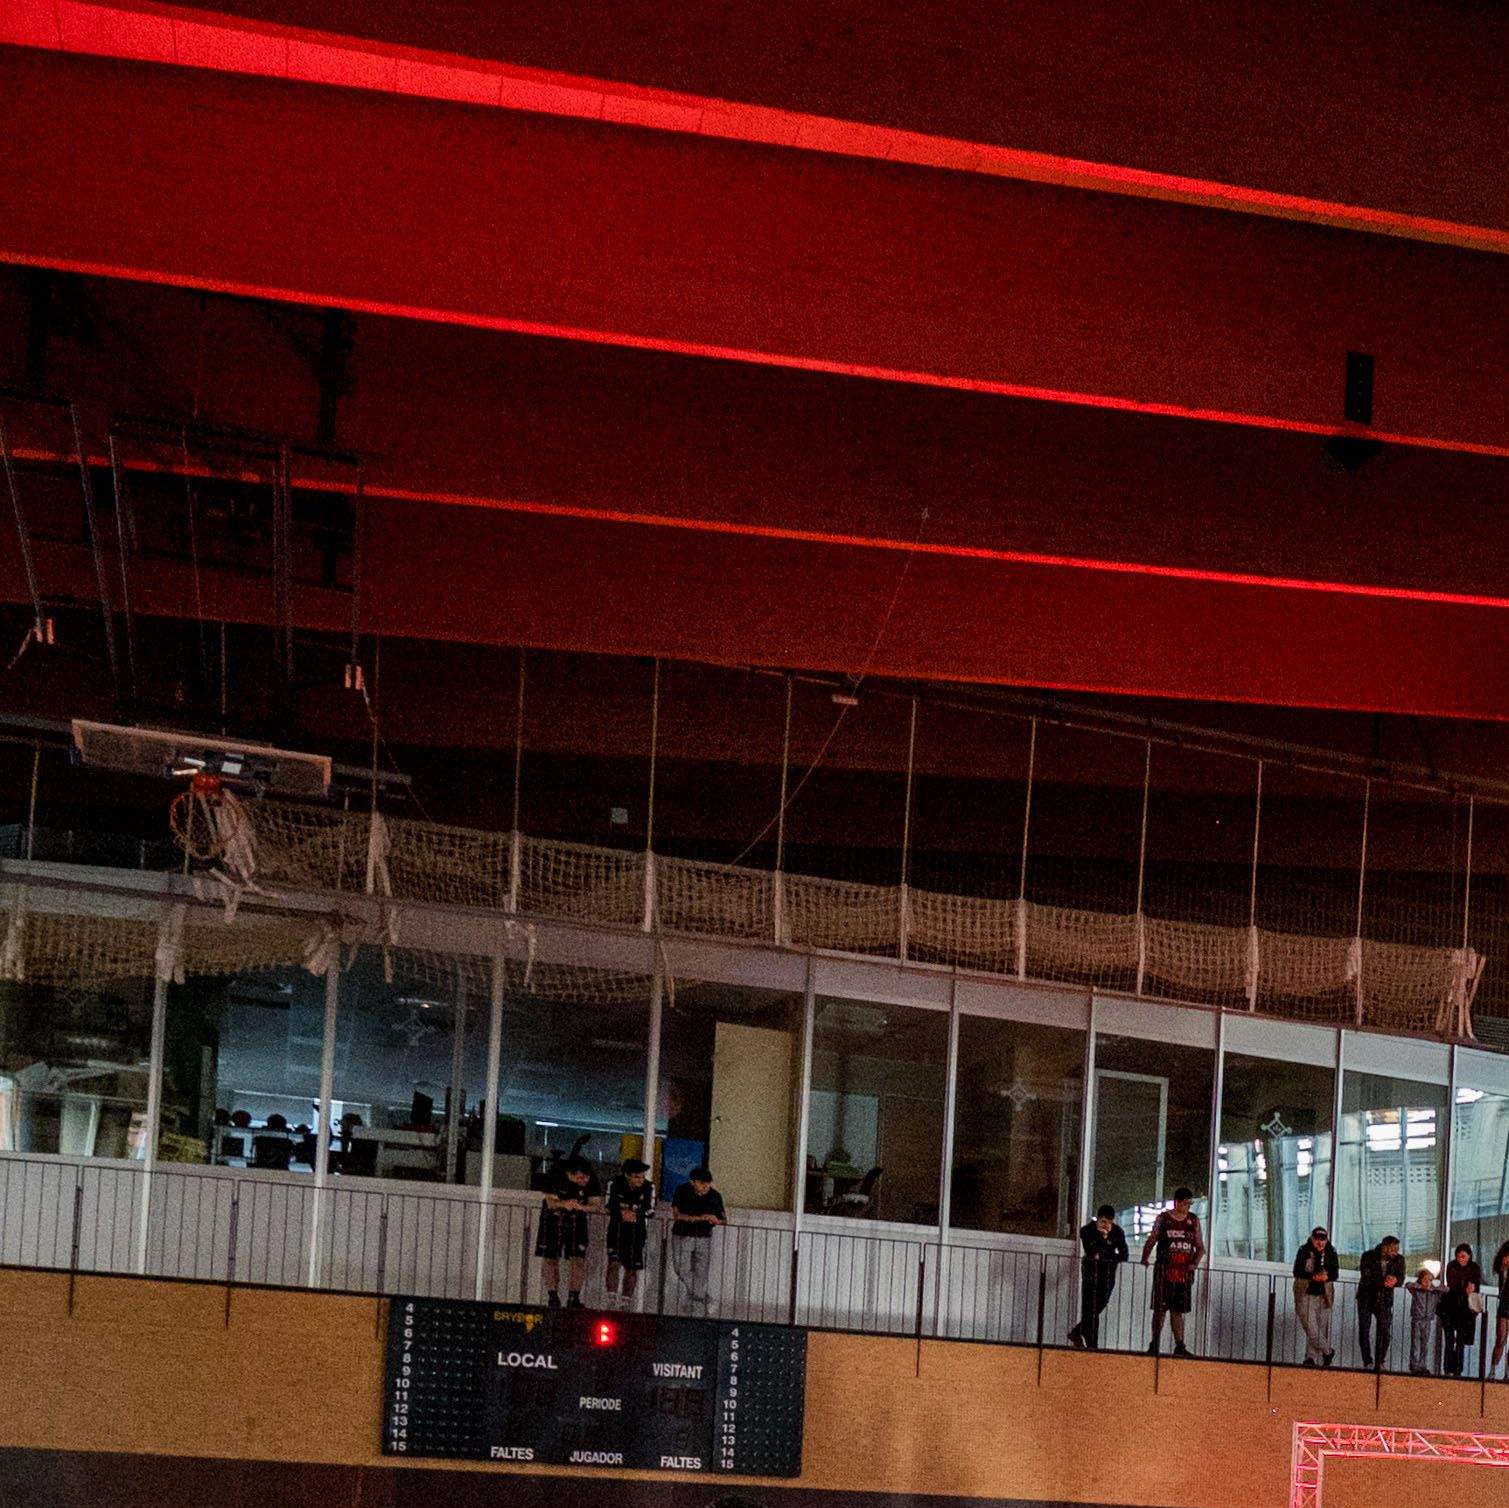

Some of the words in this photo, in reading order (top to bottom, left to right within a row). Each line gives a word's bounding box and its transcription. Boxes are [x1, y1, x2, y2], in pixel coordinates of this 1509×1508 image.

[405, 1303, 414, 1313] 4
[405, 1315, 413, 1325] 5
[404, 1328, 413, 1338] 6
[731, 1328, 739, 1337] 4
[404, 1341, 412, 1350] 7
[730, 1340, 739, 1349] 5
[402, 1353, 411, 1363] 8
[497, 1352, 558, 1369] LOCAL
[730, 1352, 738, 1361] 6
[402, 1366, 411, 1376] 9
[652, 1363, 704, 1379] VISITANT
[730, 1364, 738, 1373] 7
[395, 1378, 410, 1388] 10
[729, 1376, 738, 1385] 8
[395, 1391, 408, 1401] 11
[729, 1388, 737, 1397] 9
[393, 1403, 408, 1413] 12
[579, 1396, 622, 1411] PERIODE
[722, 1400, 737, 1409] 10
[392, 1416, 408, 1426] 13
[722, 1412, 735, 1421] 11
[392, 1428, 407, 1439] 14
[722, 1424, 736, 1433] 12
[721, 1436, 735, 1445] 13
[391, 1441, 407, 1451] 15
[490, 1446, 534, 1460] FALTES
[569, 1451, 623, 1464] JUGADOR
[720, 1448, 735, 1457] 14
[660, 1456, 702, 1470] FALTES
[720, 1459, 734, 1469] 15
